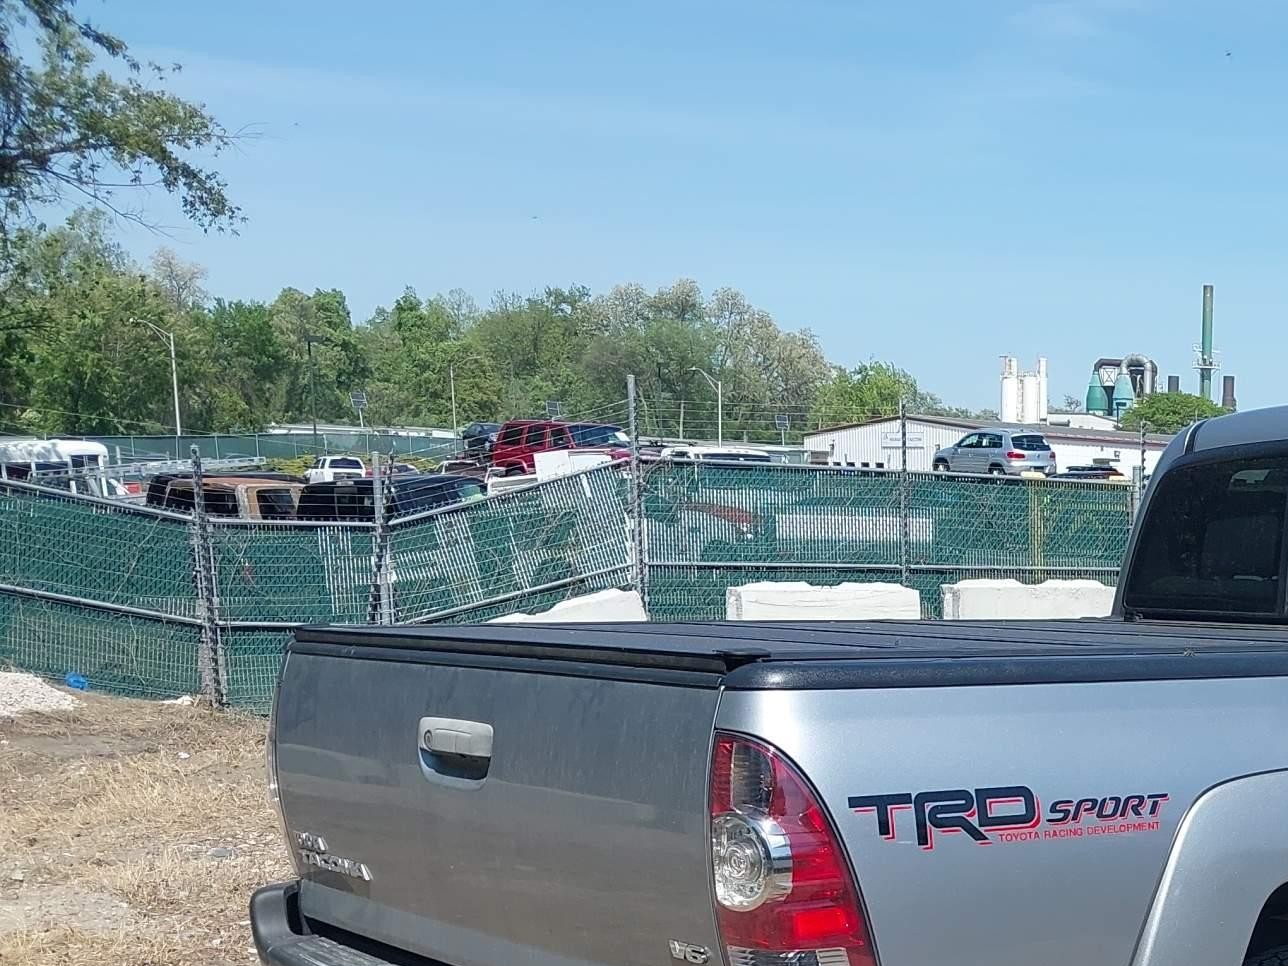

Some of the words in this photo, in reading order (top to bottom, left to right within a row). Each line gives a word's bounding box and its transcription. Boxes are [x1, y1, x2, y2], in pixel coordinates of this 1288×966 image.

[848, 785, 1041, 851] TRD
[1046, 793, 1169, 825] SPORT
[999, 830, 1040, 843] TOYOTA
[1043, 827, 1084, 840] RACING
[1087, 821, 1161, 835] DEVELOPMENT
[668, 939, 712, 964] V6
